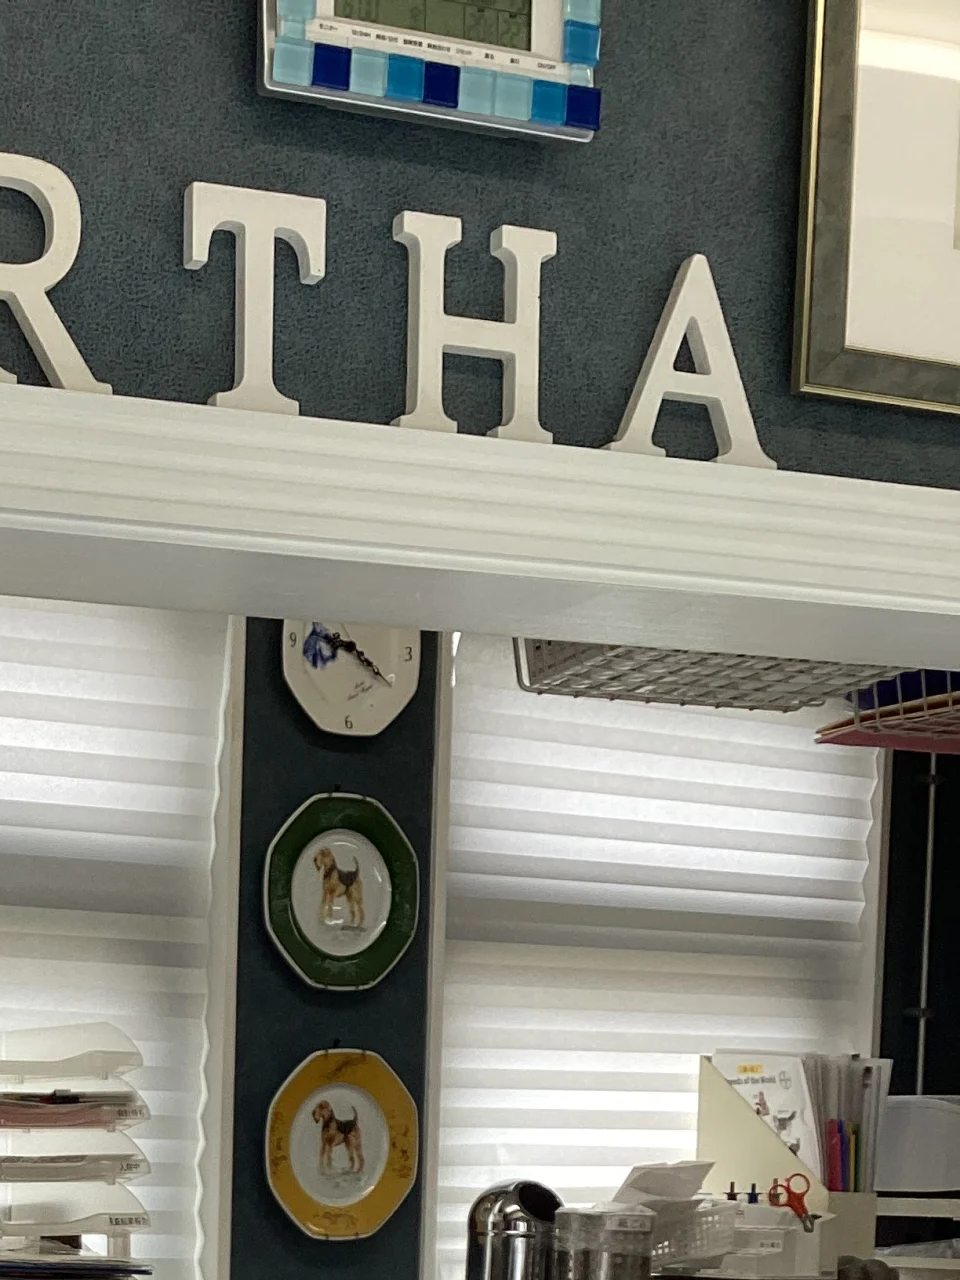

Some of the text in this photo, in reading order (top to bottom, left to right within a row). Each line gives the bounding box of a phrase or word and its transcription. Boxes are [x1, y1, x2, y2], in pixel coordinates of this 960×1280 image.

[290, 632, 297, 647] 9
[404, 646, 413, 662] 3
[344, 715, 353, 729] 6
